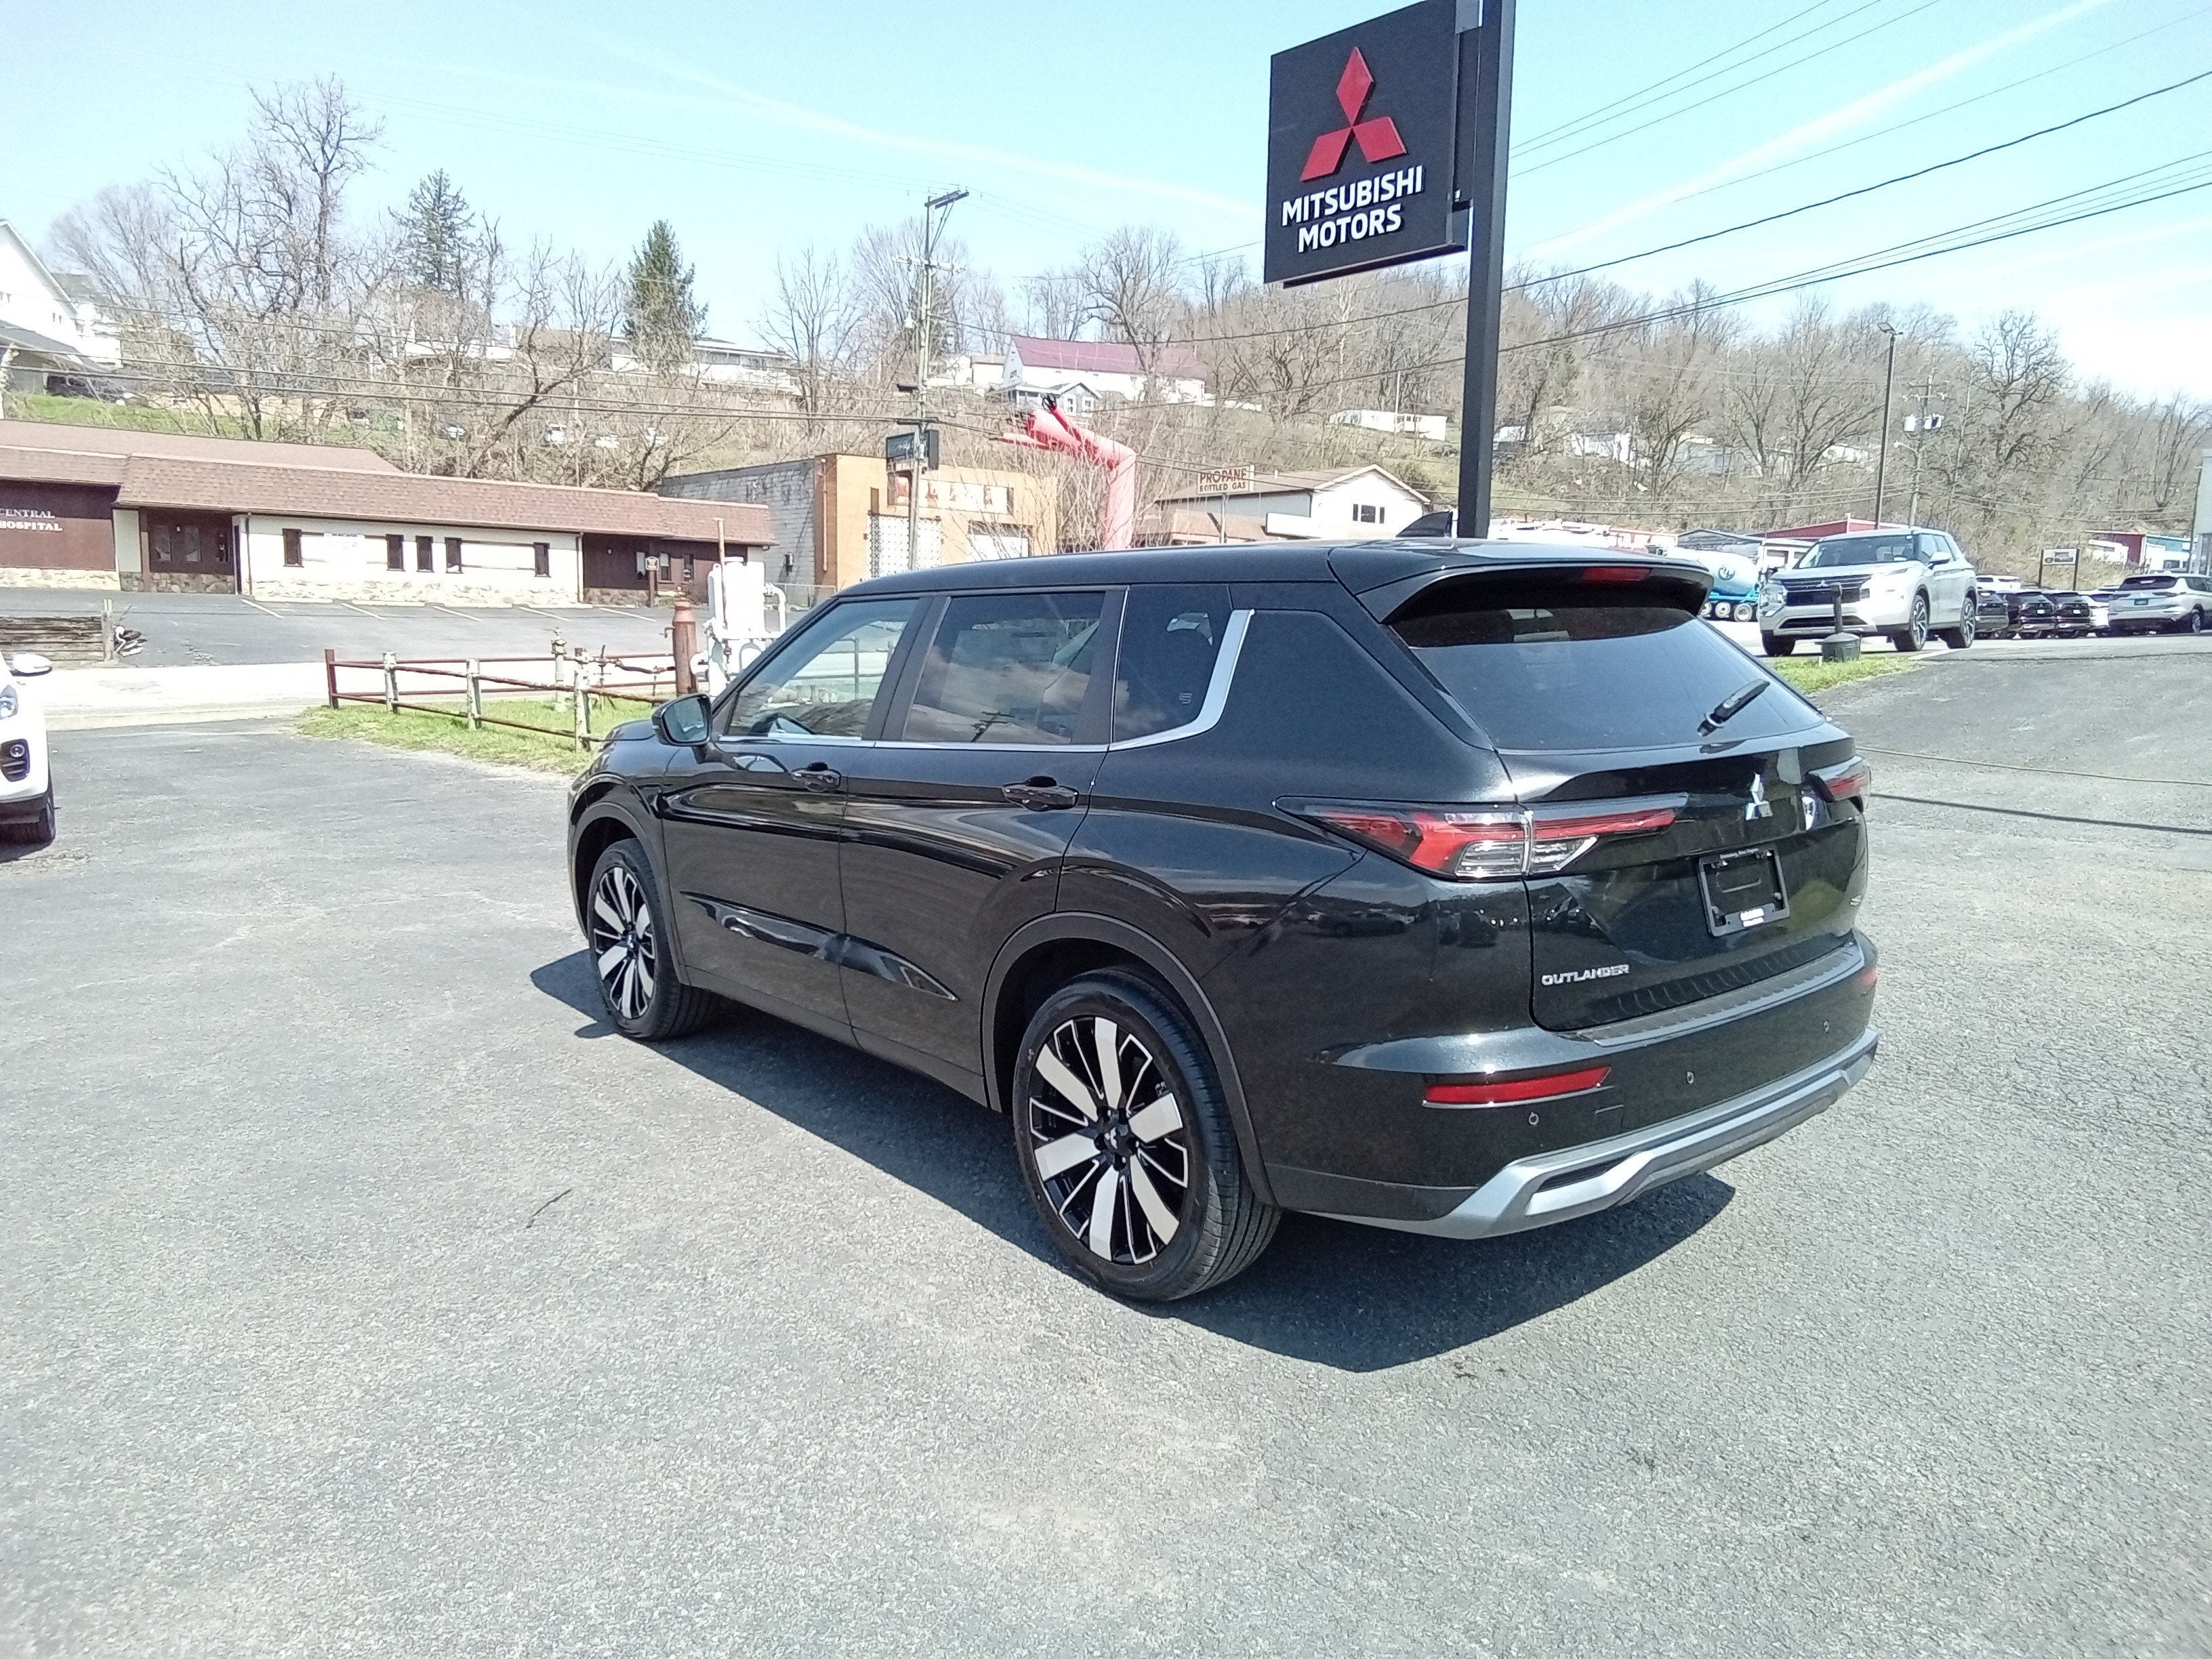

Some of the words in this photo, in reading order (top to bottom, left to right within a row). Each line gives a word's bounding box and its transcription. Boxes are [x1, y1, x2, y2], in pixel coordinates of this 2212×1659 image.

[1282, 165, 1423, 226] MITSUBISHI
[1298, 203, 1402, 253] MOTORS
[1199, 468, 1247, 484] PROPANE
[1200, 483, 1228, 493] BOTTLED
[1232, 482, 1246, 490] GAS
[1541, 964, 1630, 986] OUTLANDER
